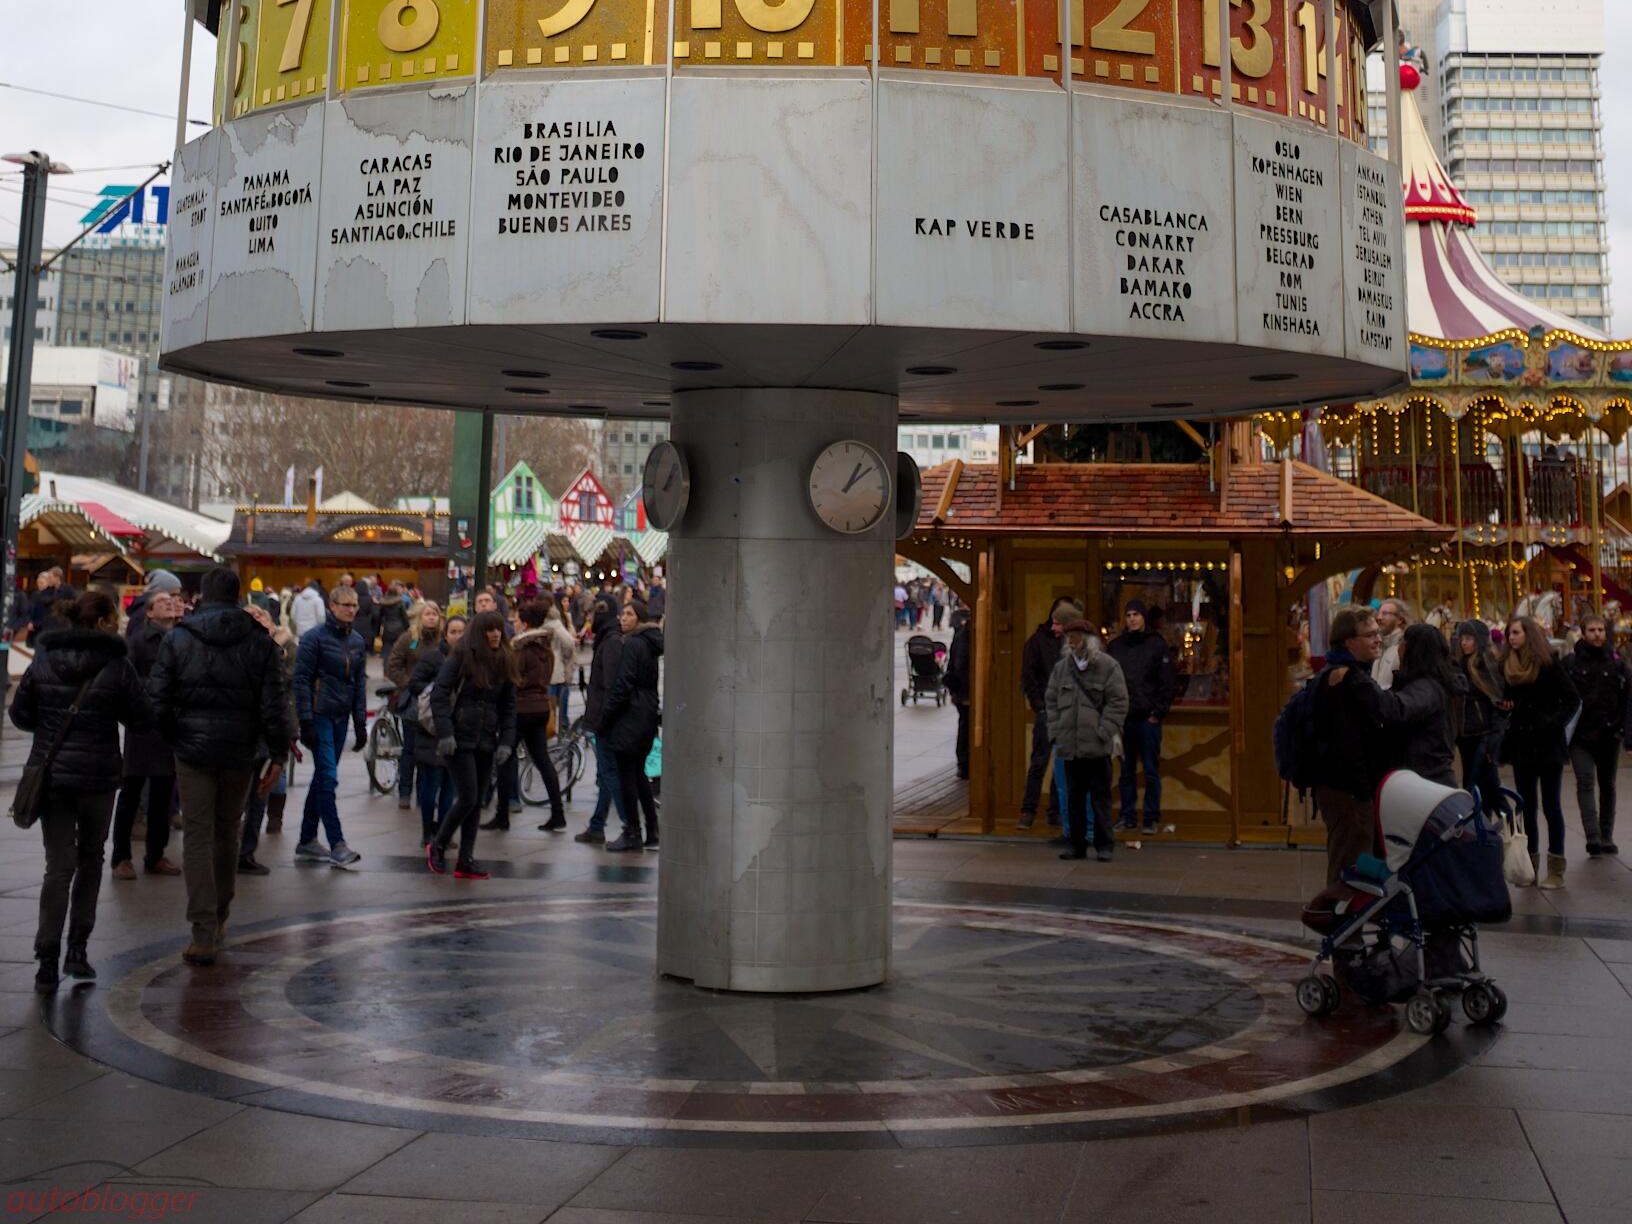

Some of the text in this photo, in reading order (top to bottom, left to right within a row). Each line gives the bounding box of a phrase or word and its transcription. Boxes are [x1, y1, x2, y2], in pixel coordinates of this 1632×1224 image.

[524, 120, 617, 139] BRASILIA
[494, 142, 644, 163] RIO DE JANEIRO
[1275, 140, 1300, 160] OSLO
[360, 153, 432, 175] CARACAS
[1252, 156, 1323, 187] KOPENHAGEN
[243, 169, 290, 191] PANAMA
[560, 167, 619, 185] PAULO
[1357, 164, 1385, 186] ANKARA
[271, 182, 312, 208] BOGOTÁ
[367, 177, 421, 197] LA PAZ
[1275, 183, 1302, 204] WIEN
[1357, 183, 1387, 208] ISTANBUL
[355, 195, 433, 221] ASUNCIÓN
[507, 190, 625, 210] MONTEVIDEO
[249, 214, 278, 232] QUITO
[498, 214, 631, 234] BUENOS AIRES
[1099, 205, 1208, 232] CASABLANCA
[1276, 205, 1303, 225] BERN
[1362, 206, 1383, 227] ATHEN
[331, 224, 405, 244] SANTIAGO
[412, 220, 455, 239] CHILE
[915, 218, 1034, 240] KAP VERDE
[1260, 223, 1319, 250] PRESSBURG
[1359, 226, 1387, 247] TEL AVIV
[249, 237, 274, 254] LIMA
[1116, 230, 1194, 253] CONAKRY
[1128, 254, 1184, 275] DAKAR
[1266, 247, 1314, 270] BELGRAD
[1356, 245, 1391, 270] JERUSALEM
[1120, 277, 1192, 299] BAMAKO
[1280, 272, 1302, 289] ROM
[1364, 269, 1385, 287] BEIRUT
[1276, 293, 1307, 312] TUNIS
[1358, 287, 1392, 311] DAMASKUS
[1129, 302, 1184, 322] ACCRA
[1366, 310, 1385, 328] KAIRO
[1263, 313, 1320, 336] KINSHASA
[1360, 329, 1392, 352] KAPSTADT
